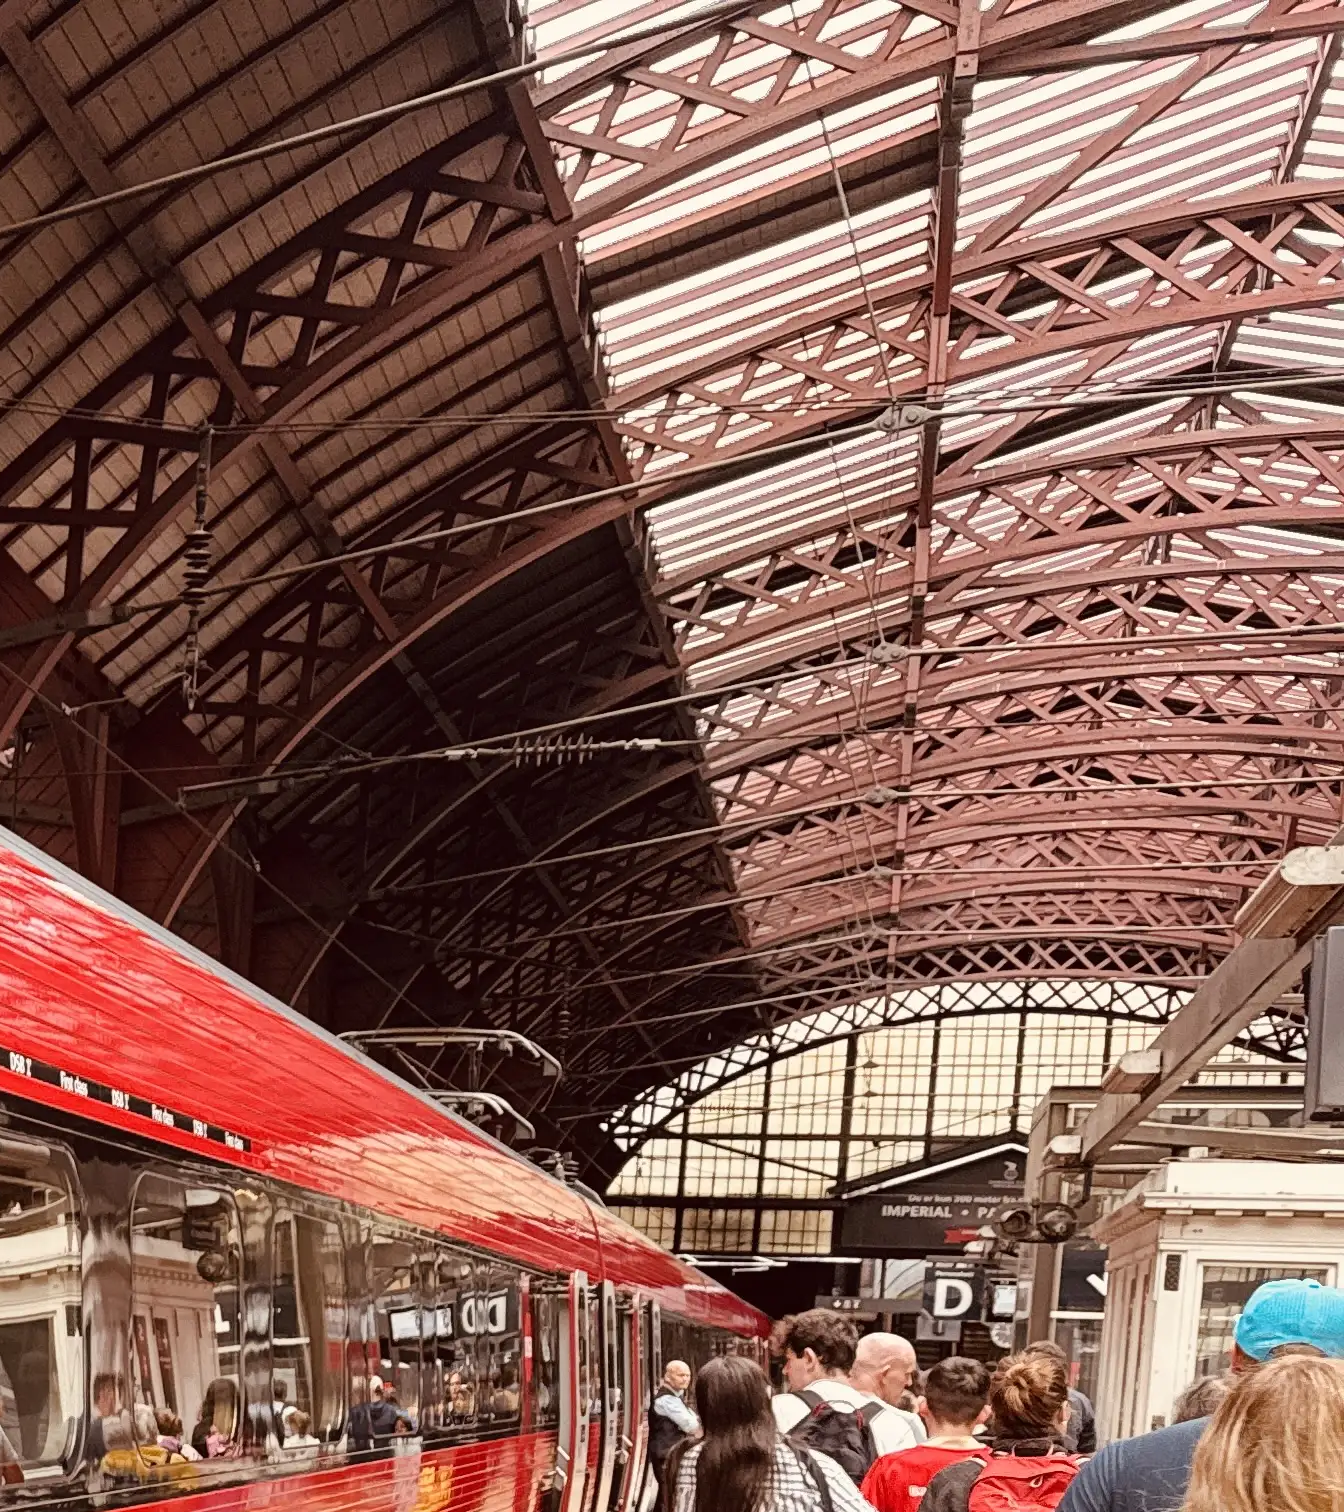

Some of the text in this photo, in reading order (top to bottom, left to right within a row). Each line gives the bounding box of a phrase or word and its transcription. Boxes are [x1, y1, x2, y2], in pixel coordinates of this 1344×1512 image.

[9, 1051, 26, 1074] DSB
[881, 1204, 953, 1218] IMPERIAL
[933, 1278, 973, 1317] D
